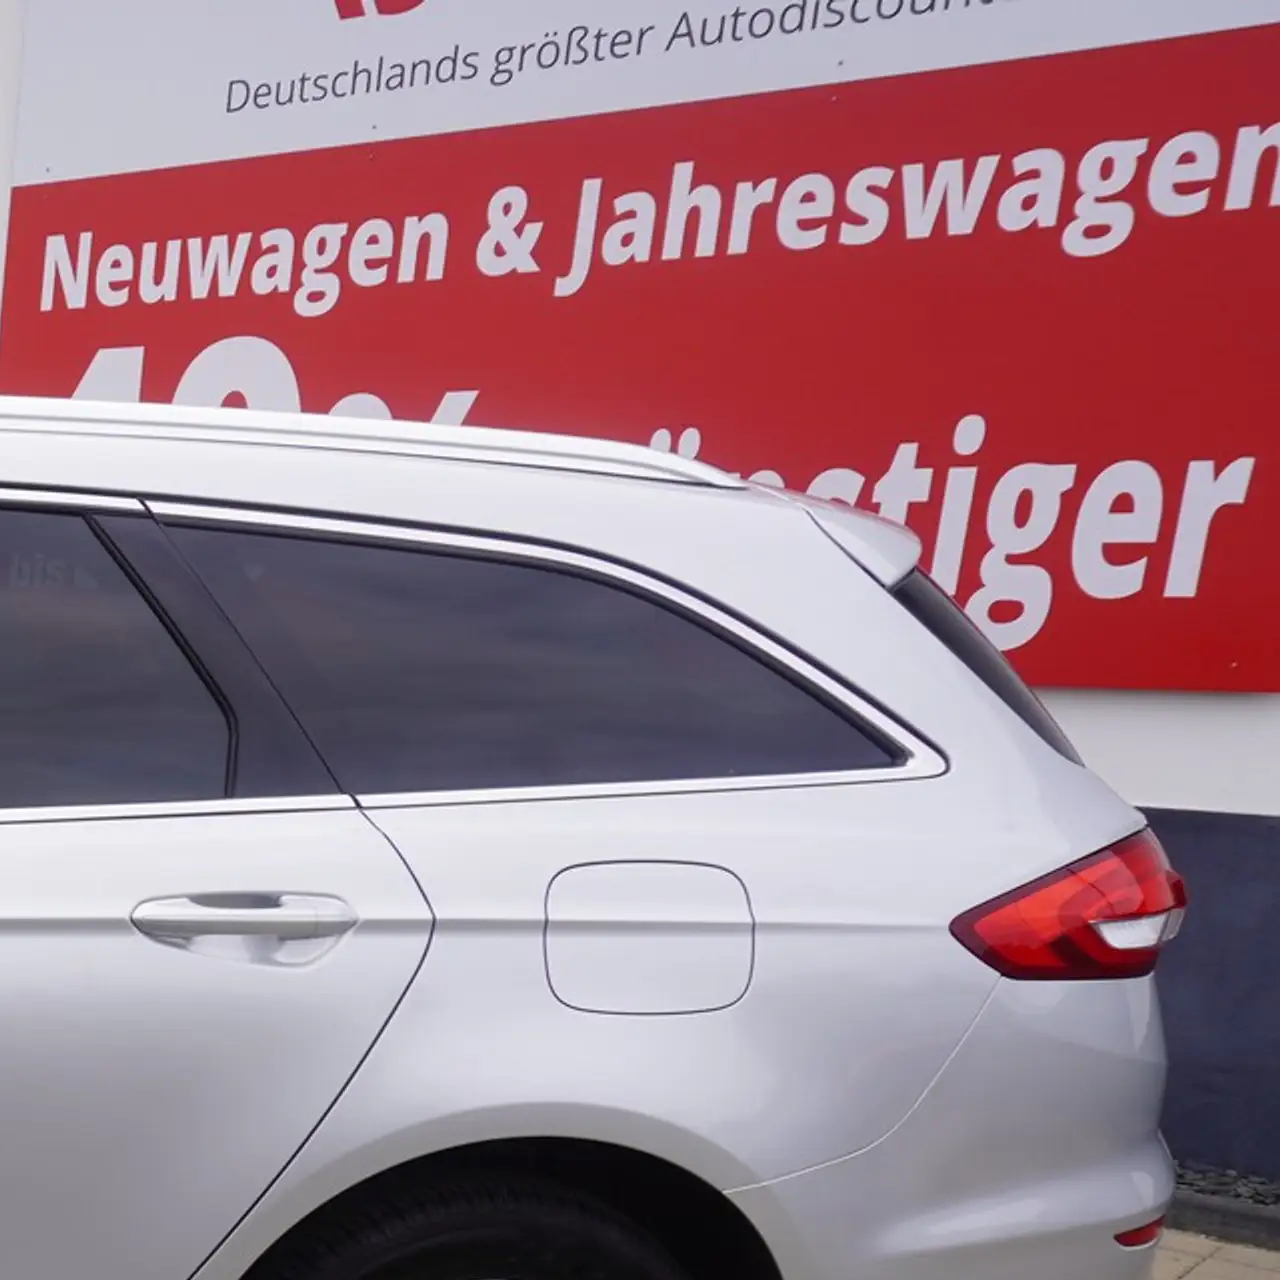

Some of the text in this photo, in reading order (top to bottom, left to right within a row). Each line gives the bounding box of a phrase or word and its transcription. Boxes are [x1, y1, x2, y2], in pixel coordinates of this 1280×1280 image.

[225, 45, 480, 113] Deutschlands
[489, 24, 656, 86] größter
[39, 120, 1280, 318] Neuwagen & Jahreswagen
